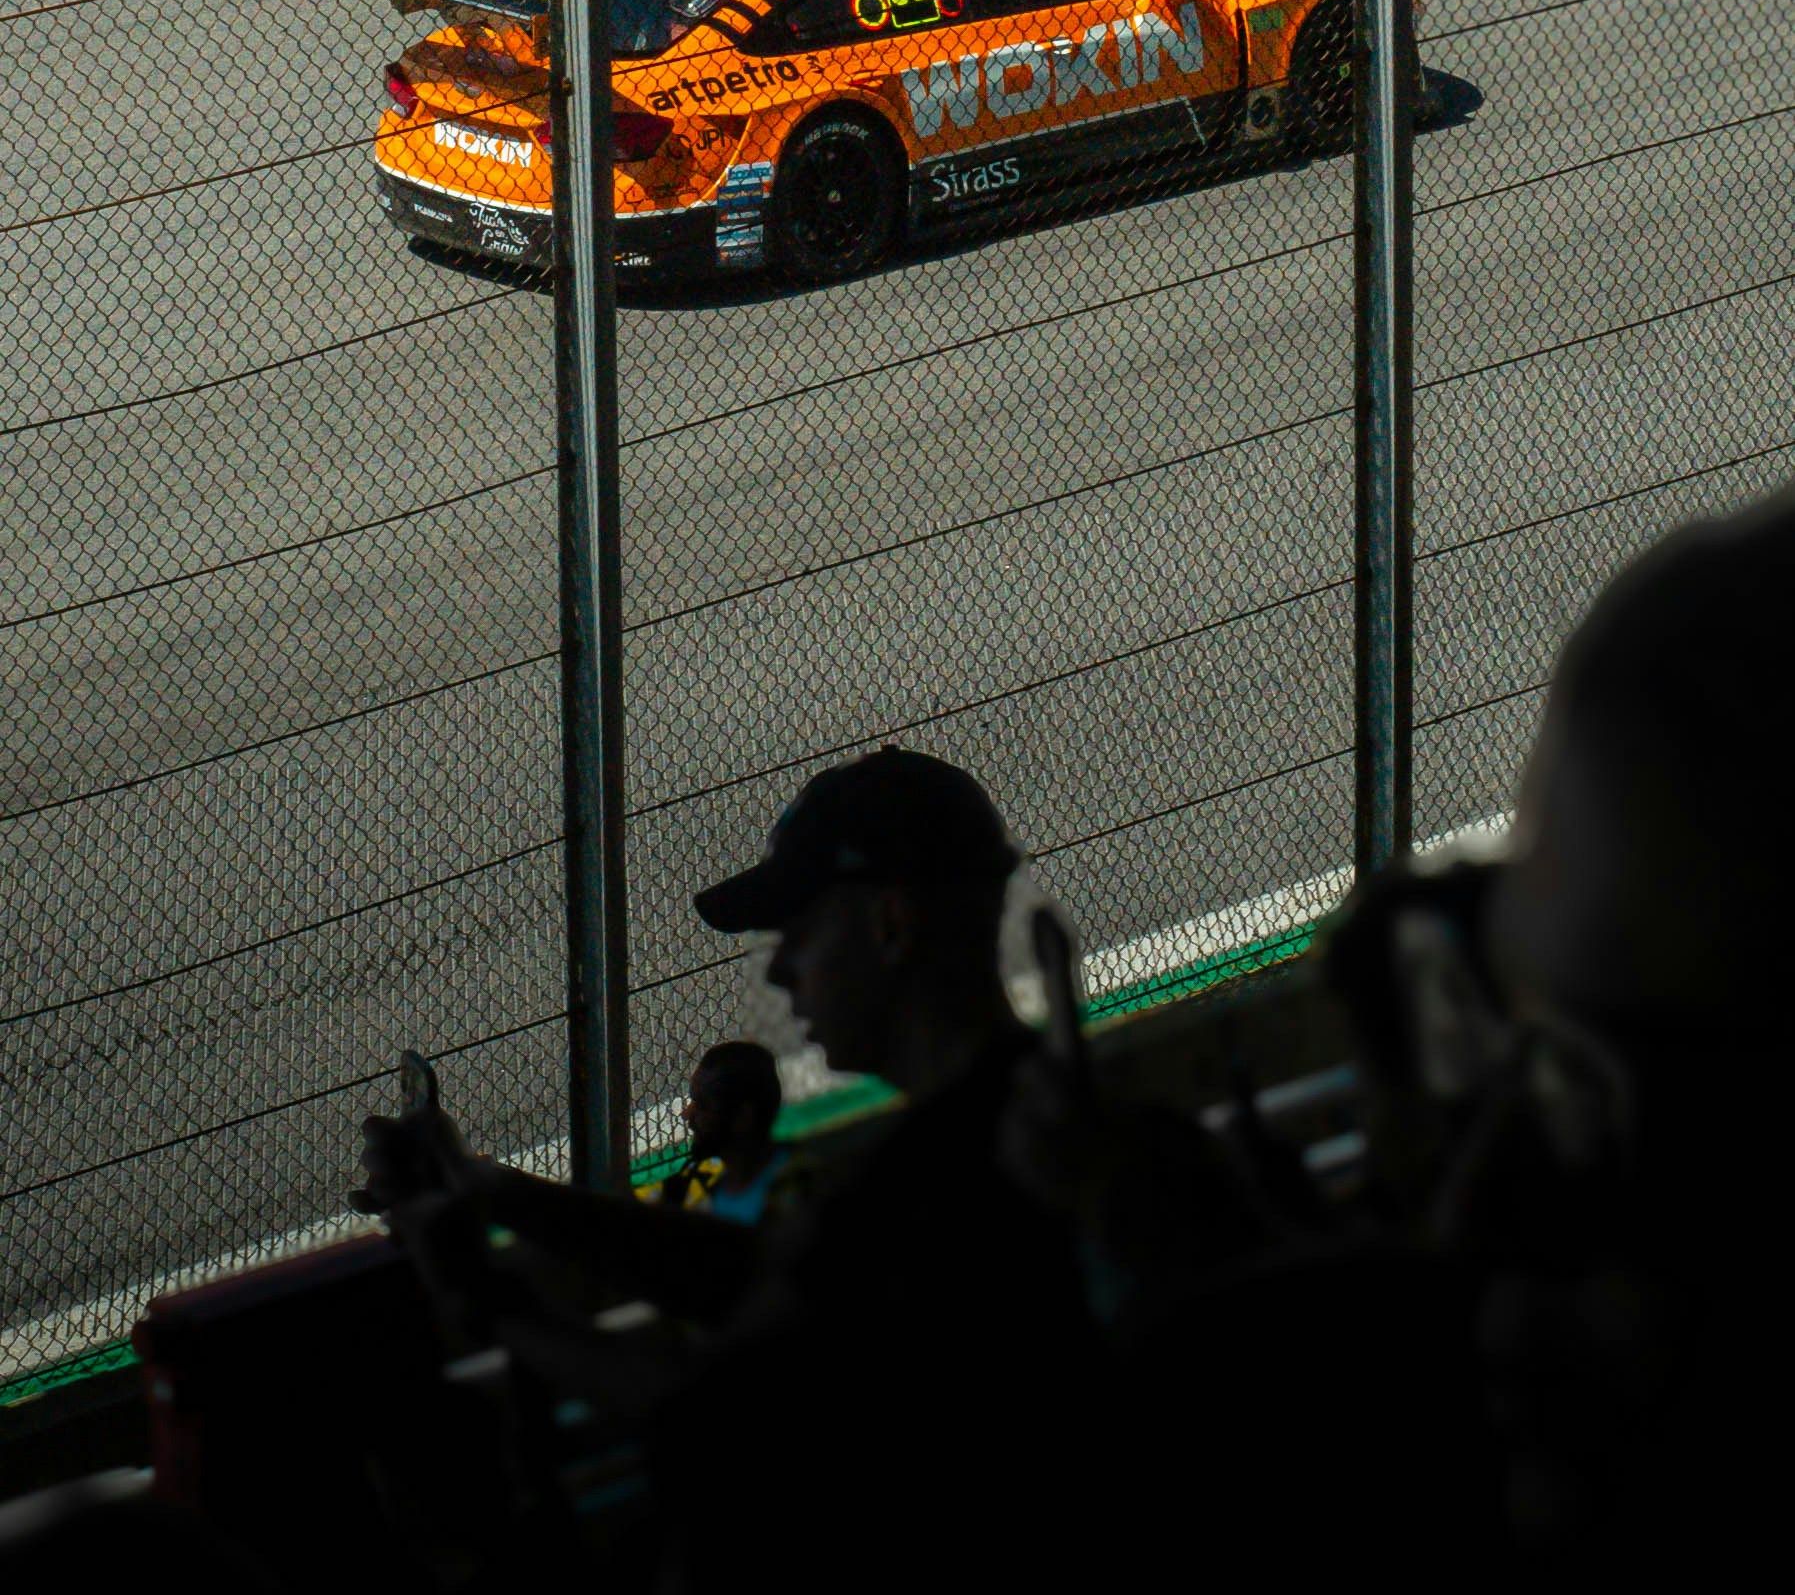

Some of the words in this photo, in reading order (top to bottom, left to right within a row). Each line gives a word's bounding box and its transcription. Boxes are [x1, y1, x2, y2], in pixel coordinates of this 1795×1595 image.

[648, 60, 799, 112] artpetro
[901, 2, 1204, 139] WOKIN
[434, 120, 533, 168] WOKIN
[930, 157, 1020, 203] Strass
